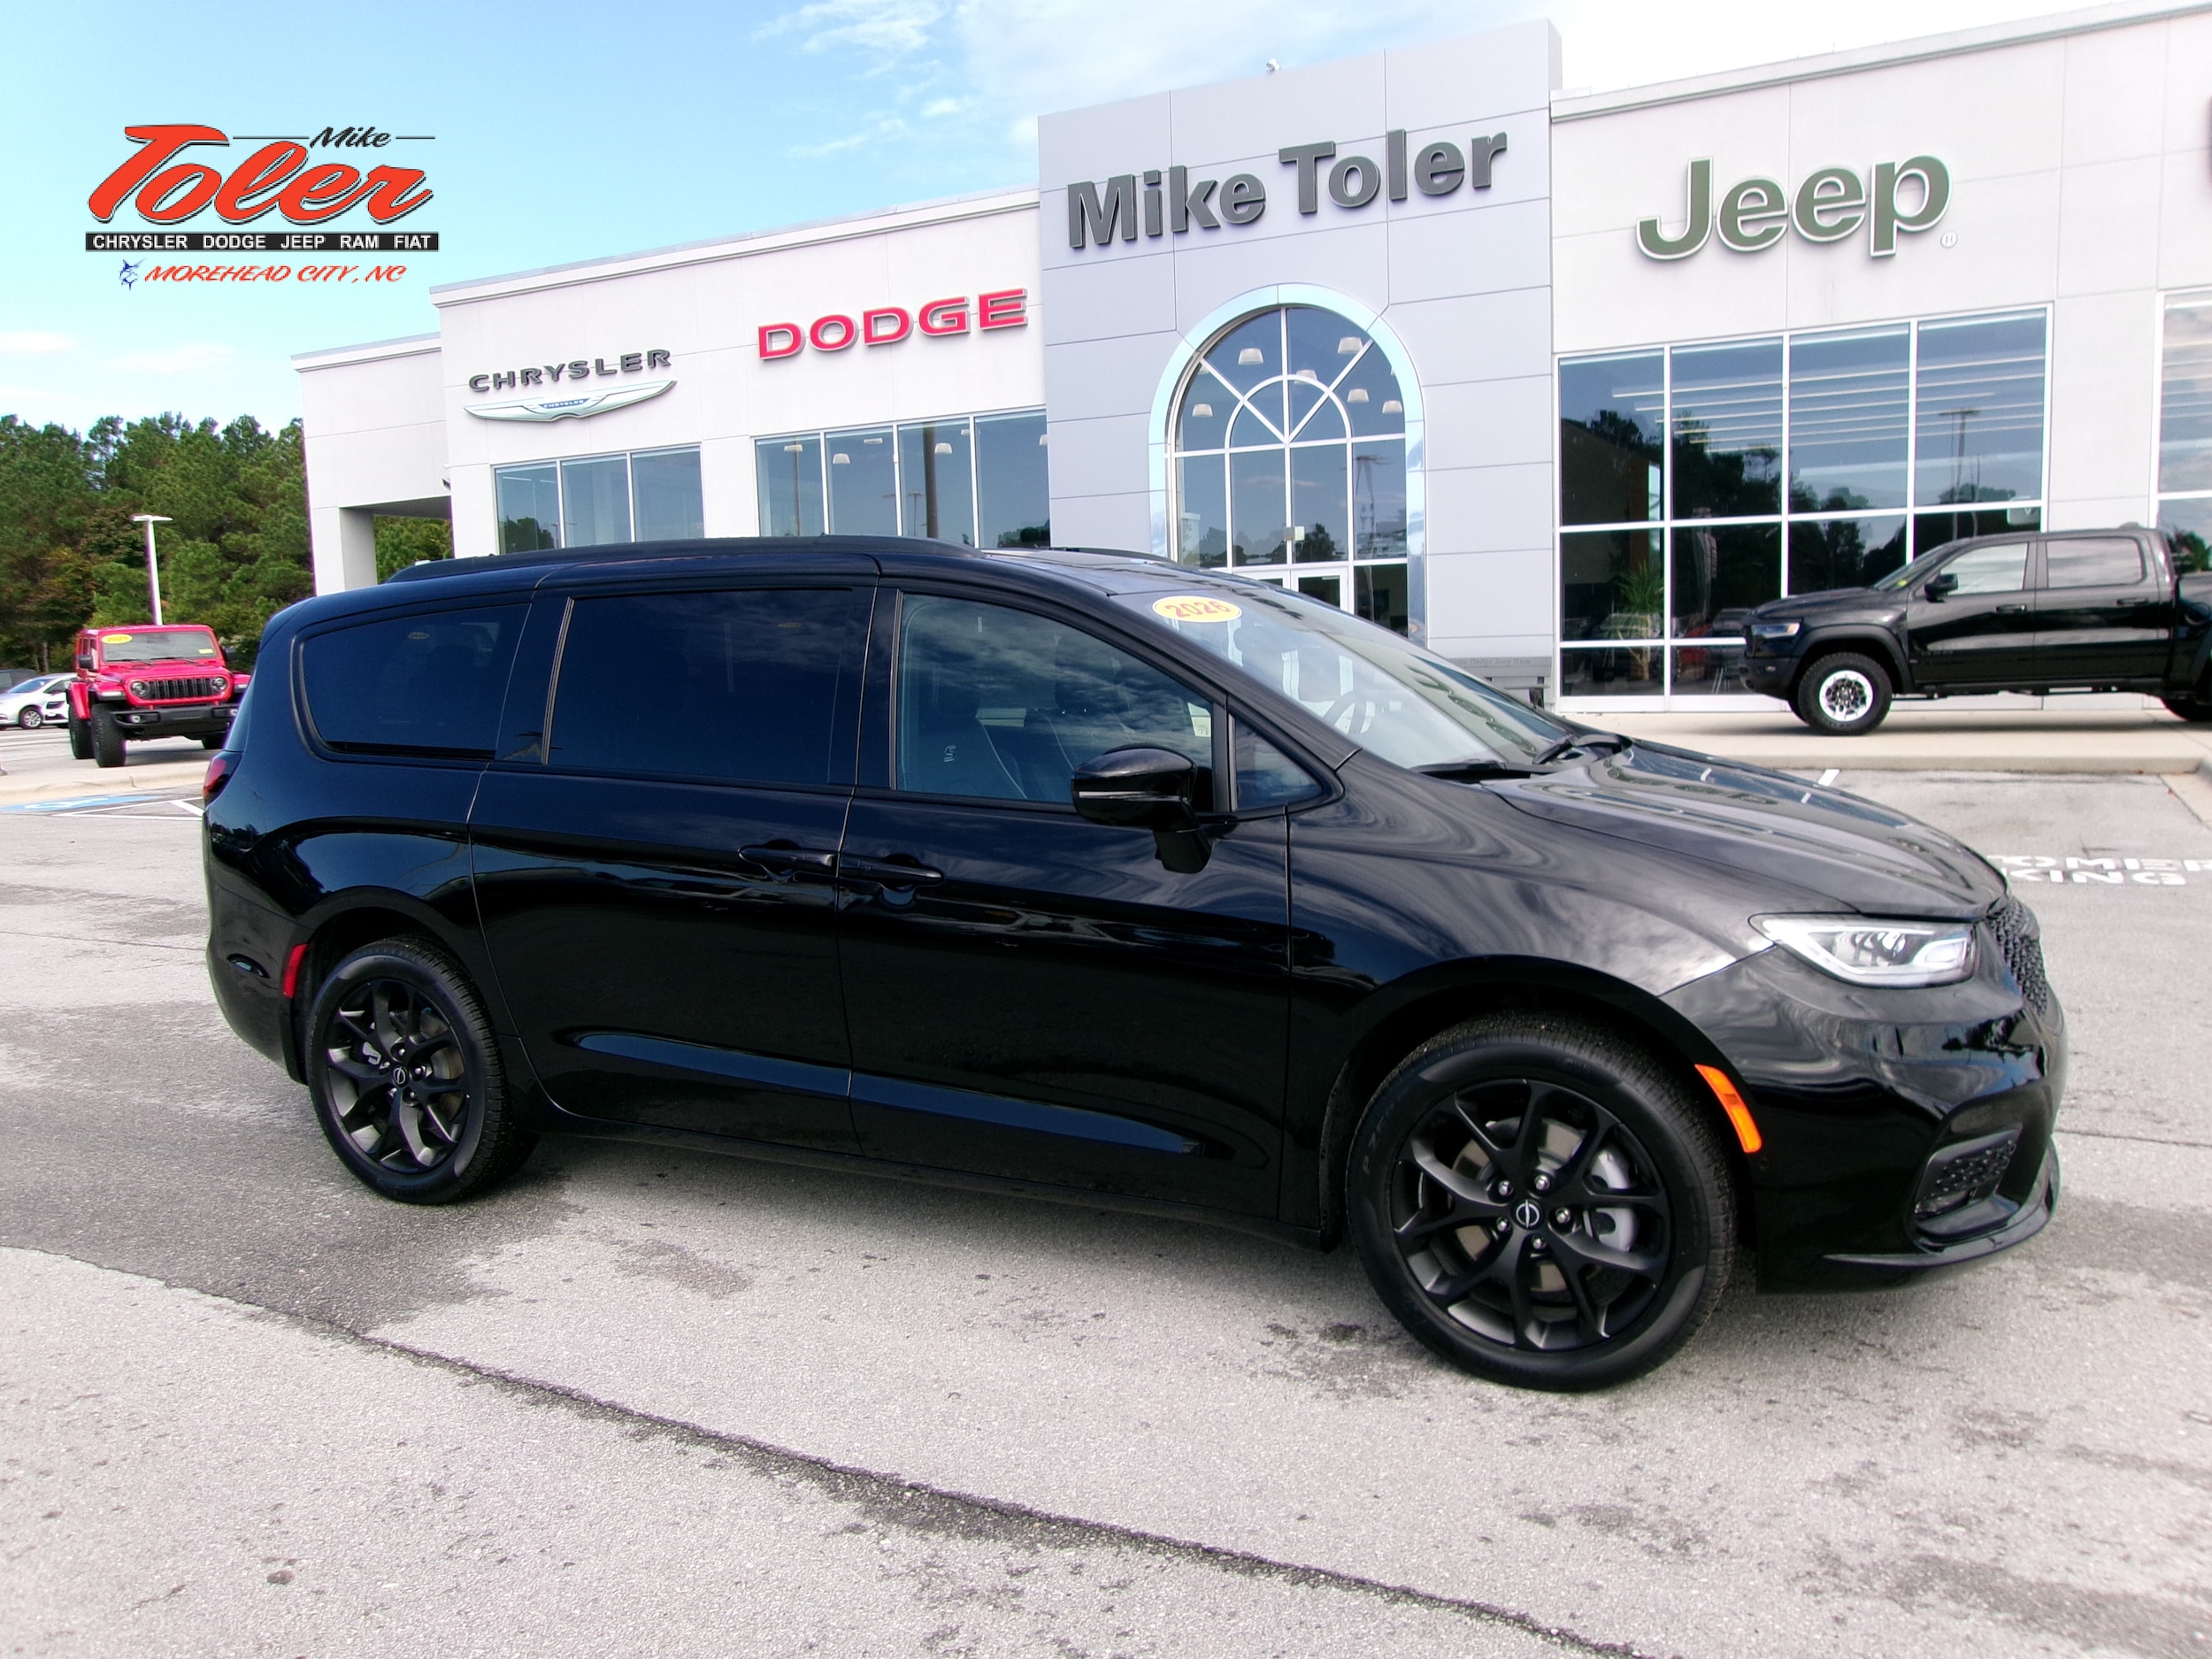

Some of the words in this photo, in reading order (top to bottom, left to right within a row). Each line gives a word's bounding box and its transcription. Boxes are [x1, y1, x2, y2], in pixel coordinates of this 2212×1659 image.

[1066, 165, 1267, 248] Mike
[1279, 129, 1509, 214] Toler
[1635, 154, 1952, 260] Jeep
[757, 288, 1029, 360] DODGE
[468, 349, 672, 392] CHRYSLER
[1164, 601, 1232, 618] 2026
